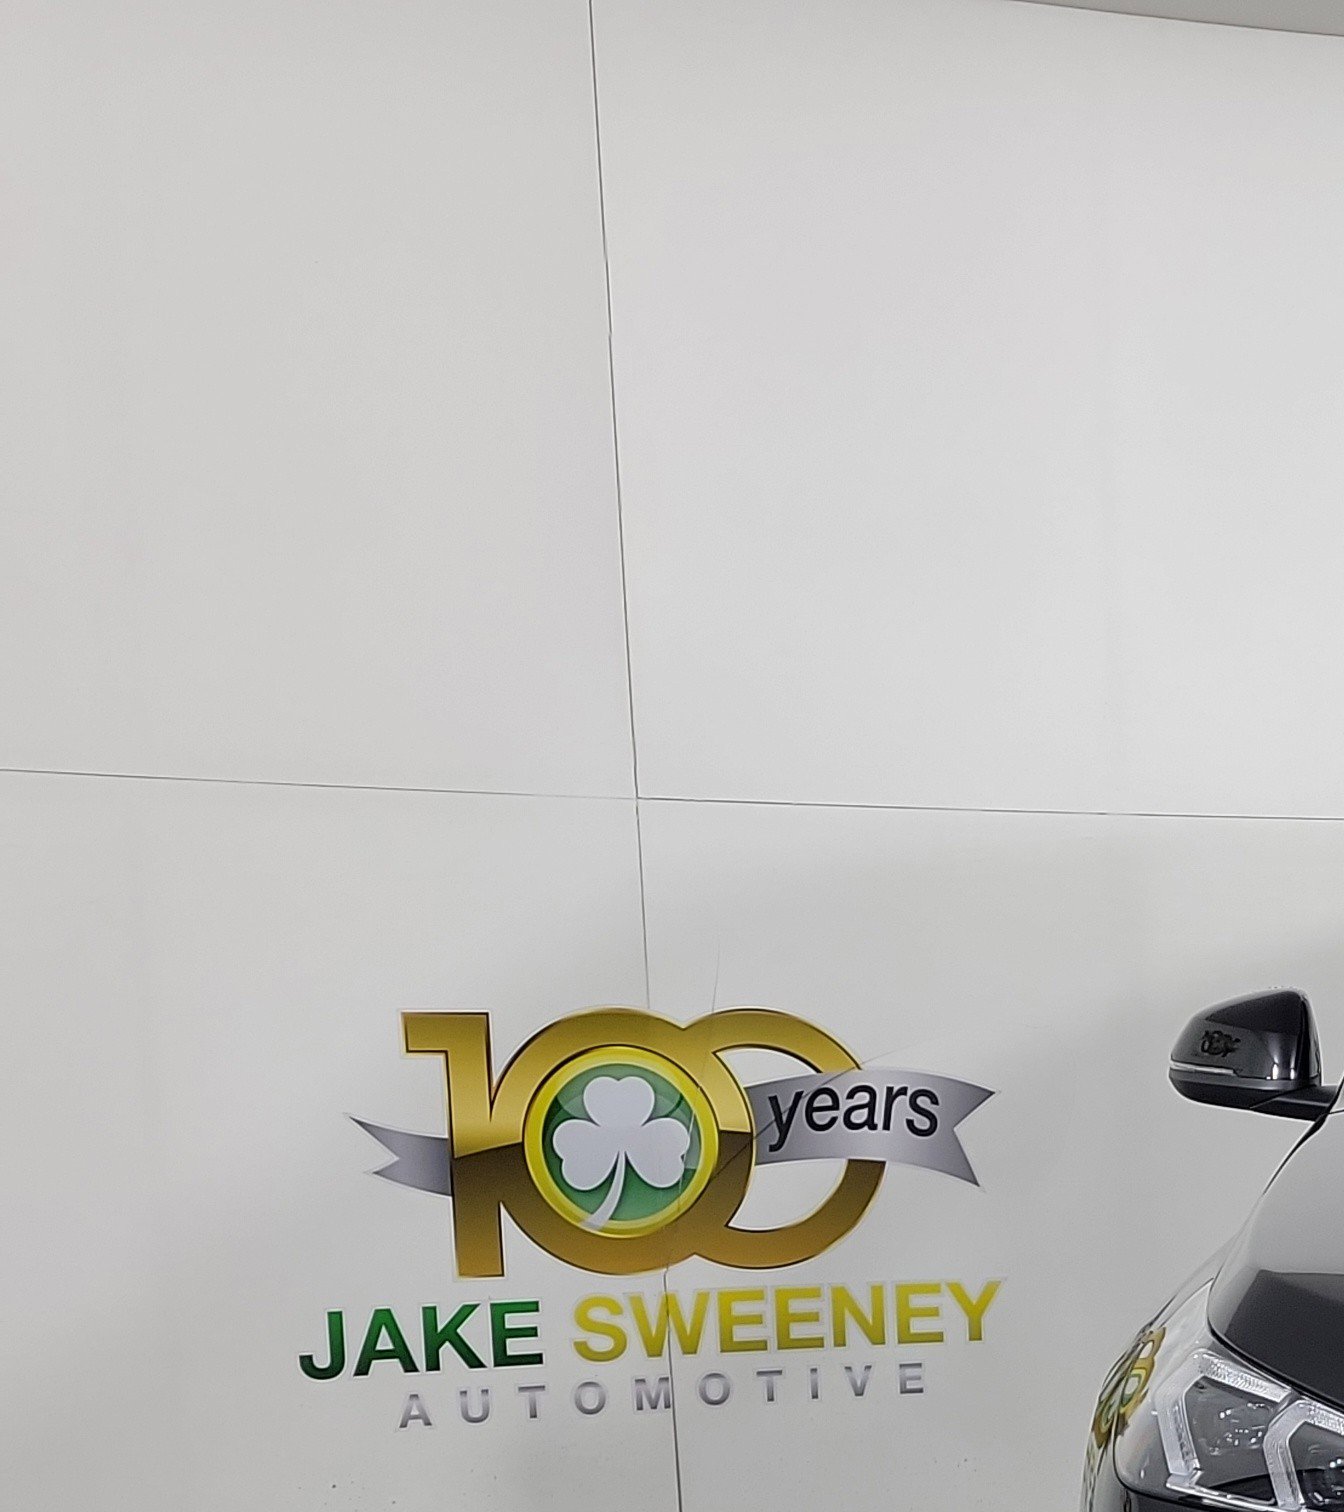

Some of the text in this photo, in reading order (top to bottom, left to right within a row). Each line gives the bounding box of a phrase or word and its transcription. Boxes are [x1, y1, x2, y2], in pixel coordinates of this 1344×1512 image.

[402, 1006, 940, 1278] 100 years
[299, 1280, 1003, 1380] JAKE SWEENEY
[398, 1362, 926, 1429] AUTOMOTIVE
